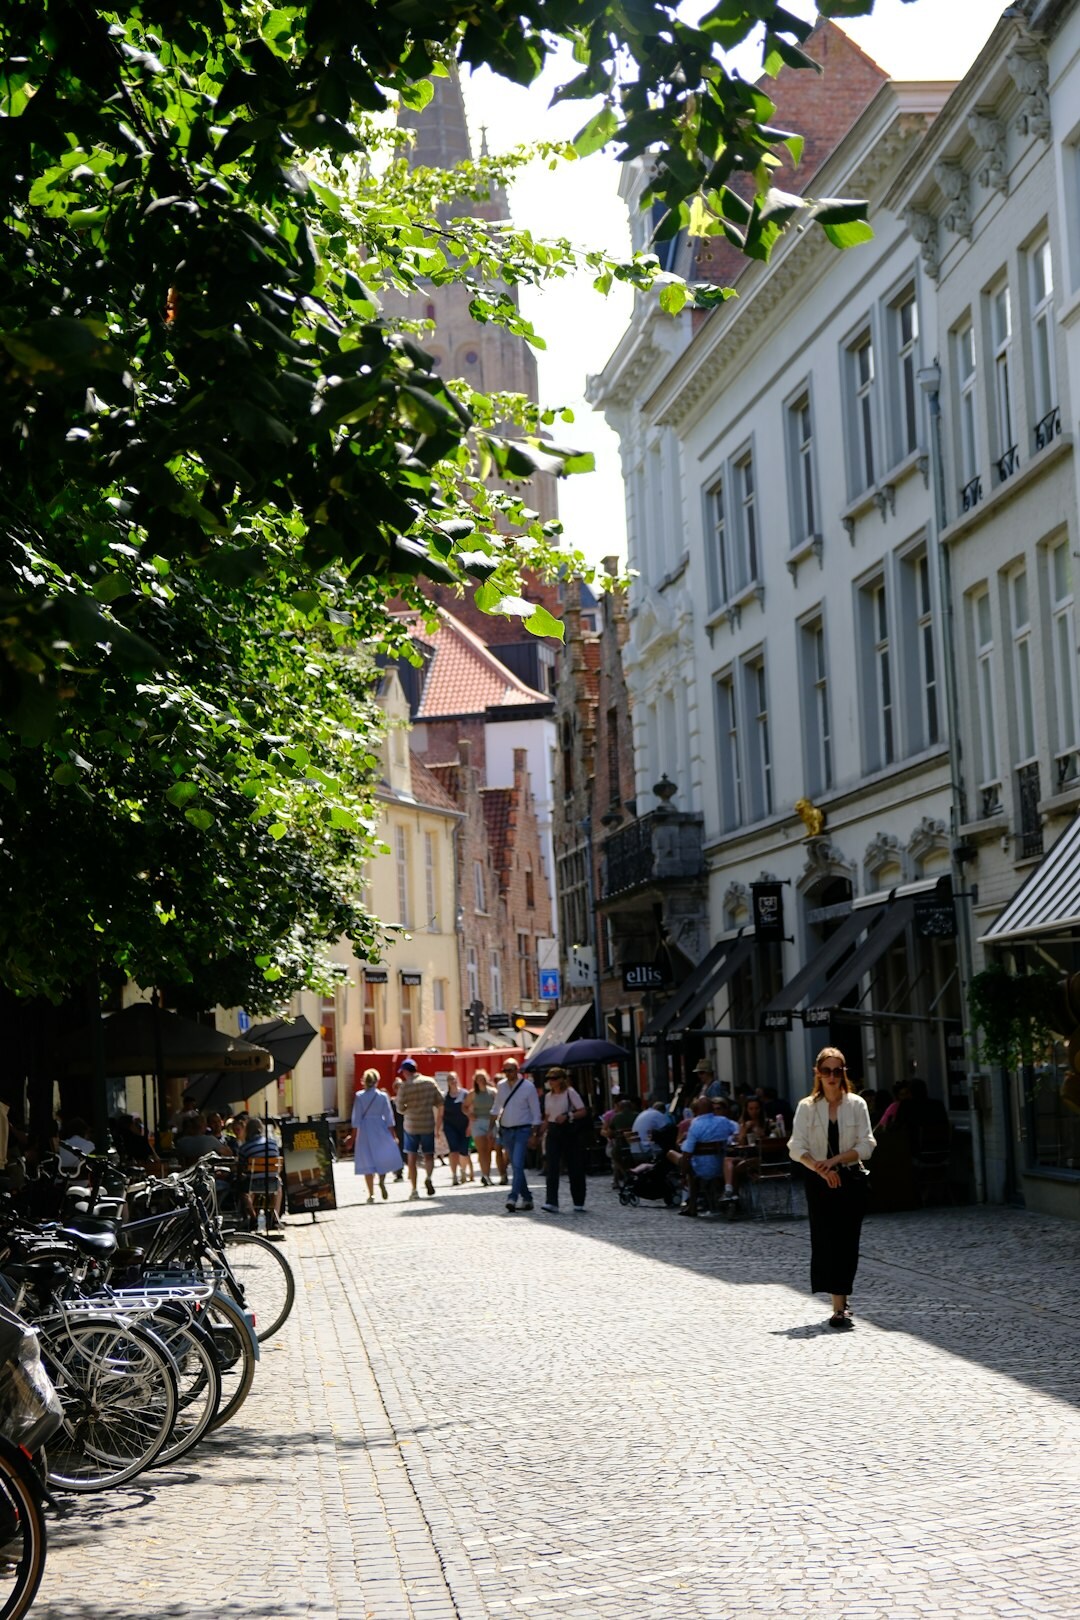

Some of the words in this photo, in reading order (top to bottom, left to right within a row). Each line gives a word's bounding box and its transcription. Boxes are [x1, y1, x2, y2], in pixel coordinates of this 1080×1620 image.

[626, 966, 663, 983] ellis
[224, 1056, 252, 1066] Duvel
[294, 1131, 316, 1142] SECRET
[304, 1198, 320, 1208] ELLIS
